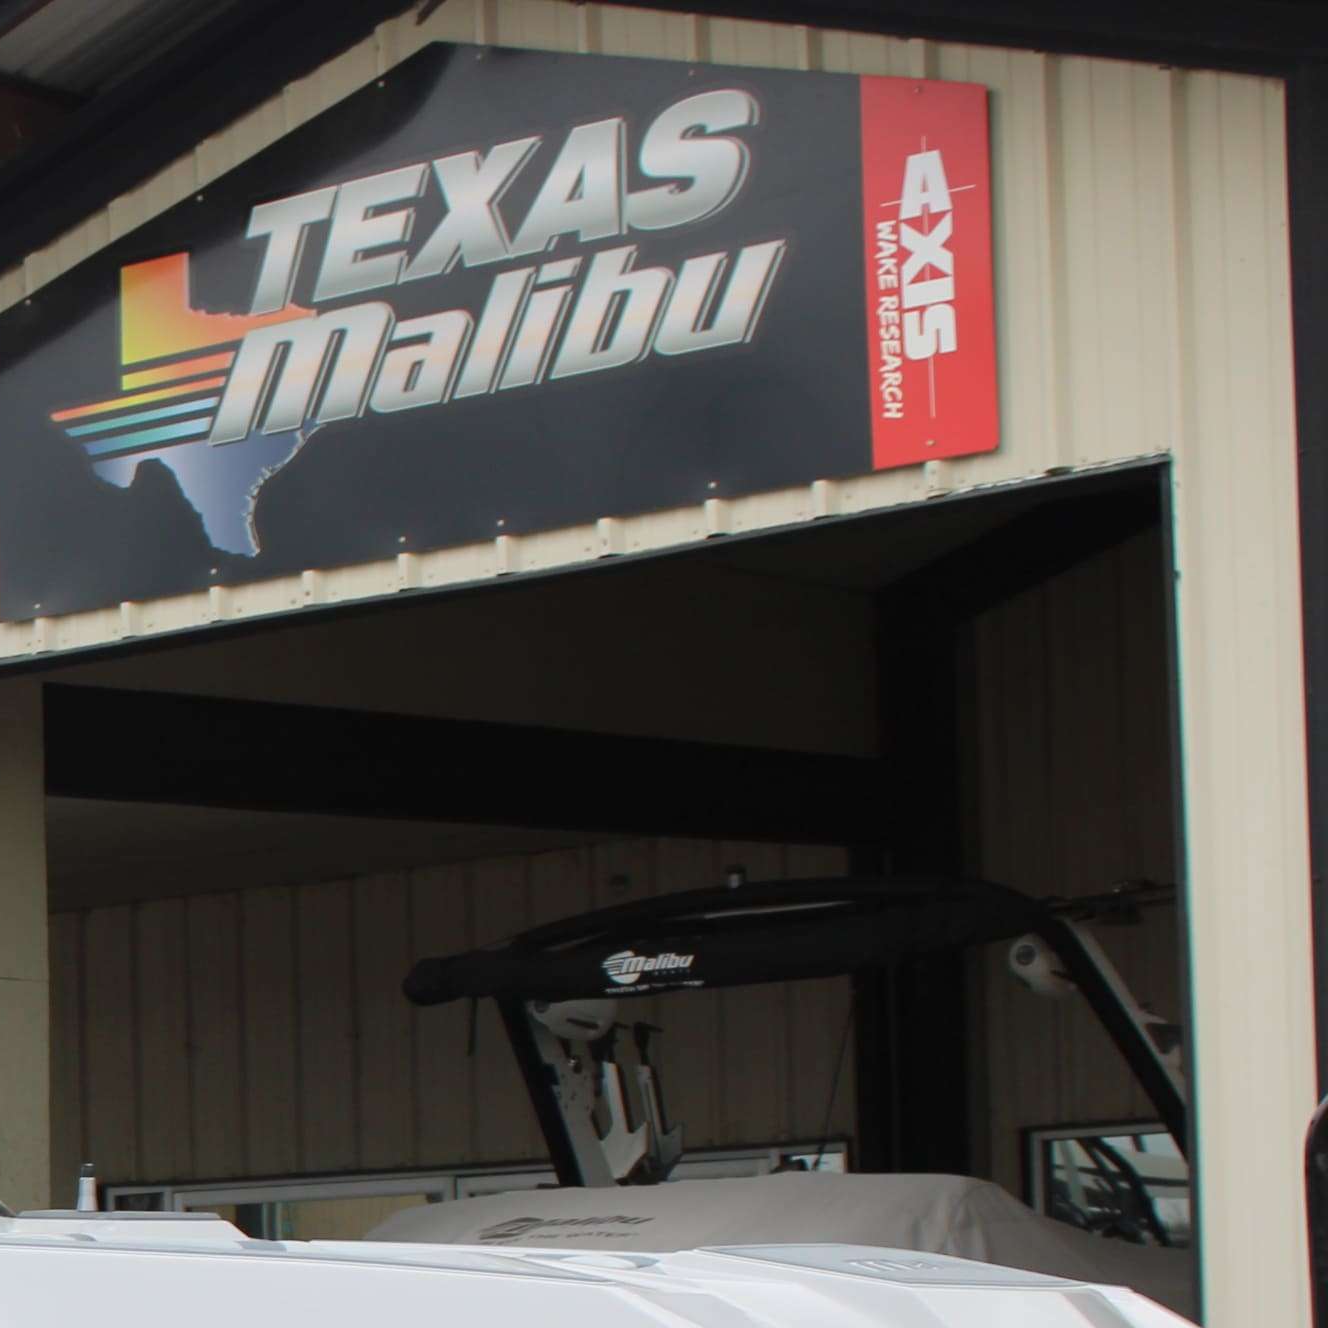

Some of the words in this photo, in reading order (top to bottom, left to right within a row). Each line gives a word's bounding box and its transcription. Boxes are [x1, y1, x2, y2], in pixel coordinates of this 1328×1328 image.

[246, 90, 760, 317] TEXAS
[874, 219, 898, 290] WAKE
[898, 149, 957, 361] AXIS
[208, 241, 786, 446] Malibu
[876, 295, 905, 420] RESEARCH
[621, 952, 695, 973] Malibu
